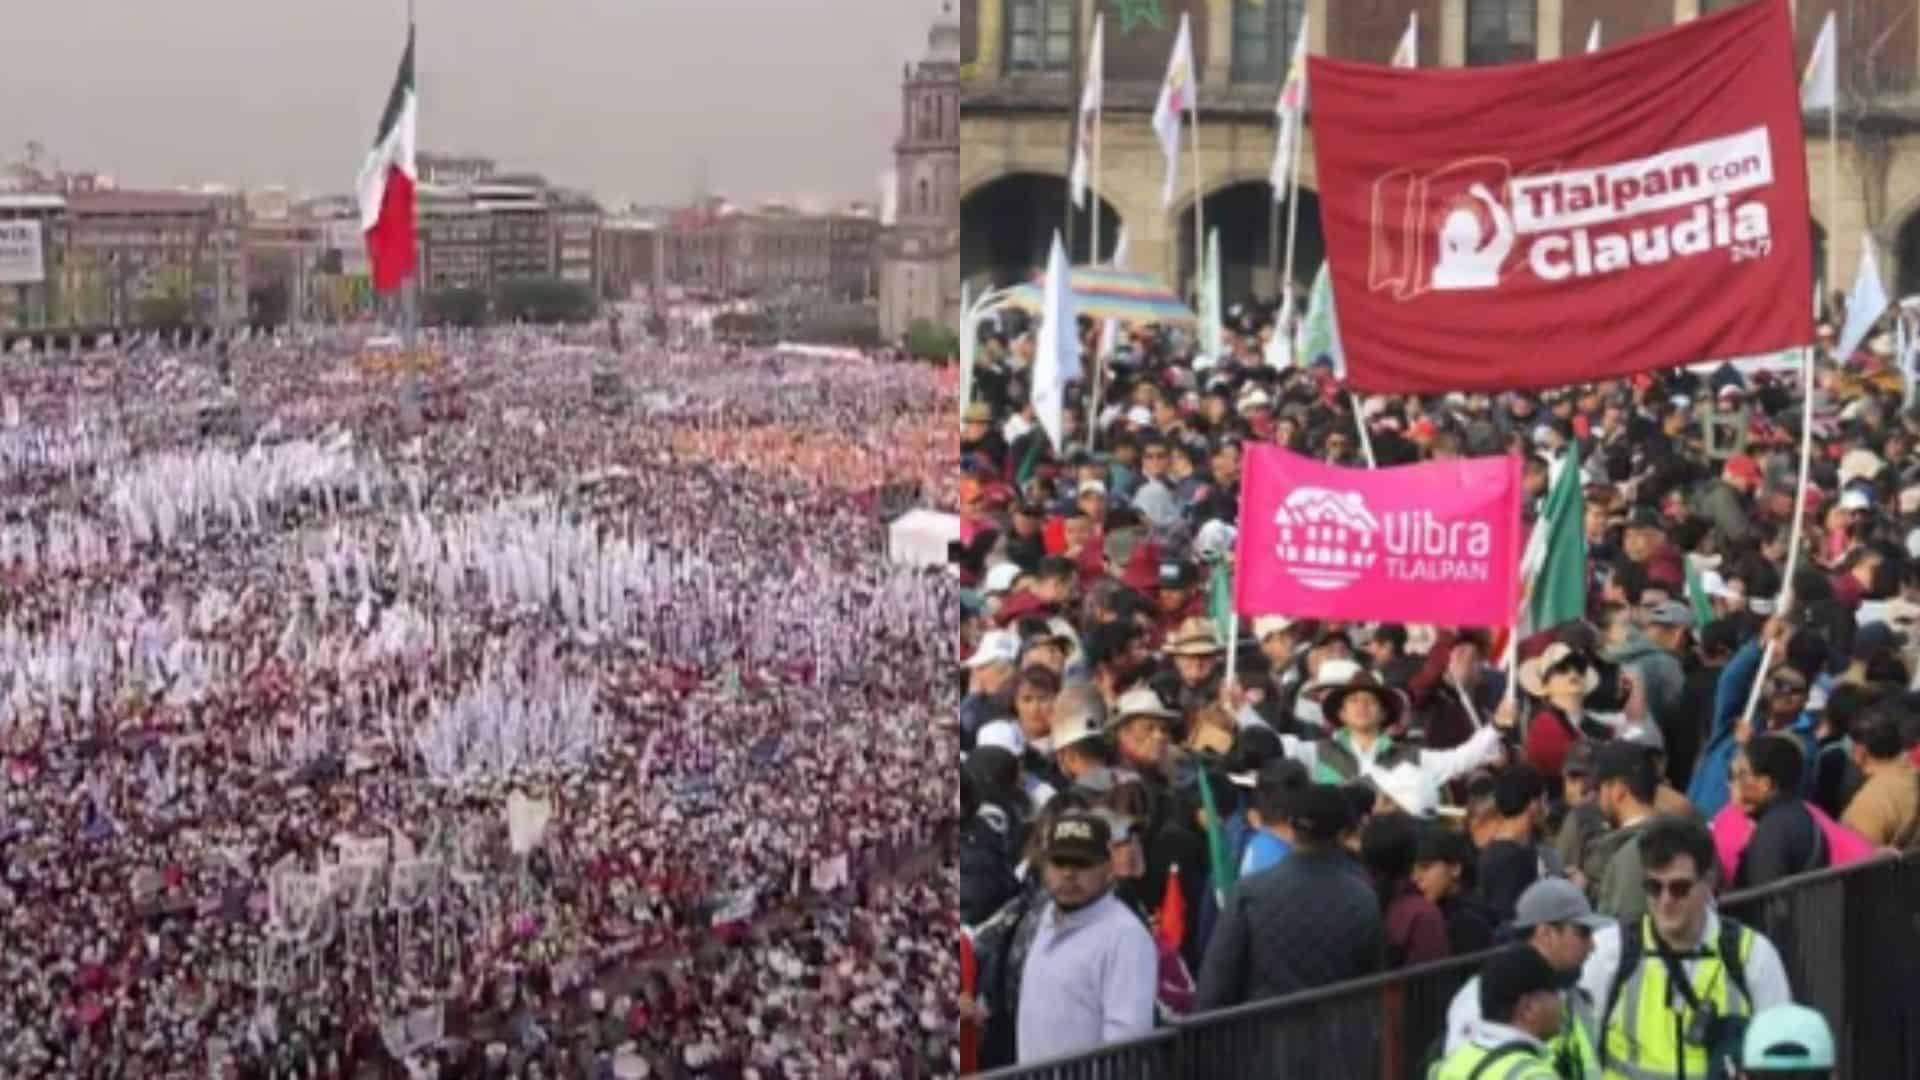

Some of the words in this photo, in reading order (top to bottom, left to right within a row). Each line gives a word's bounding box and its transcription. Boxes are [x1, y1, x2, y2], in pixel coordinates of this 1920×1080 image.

[1521, 162, 1699, 218] Tlalpan
[1707, 154, 1761, 183] con
[1529, 195, 1769, 280] Claudia
[1385, 556, 1488, 582] TLALPAN
